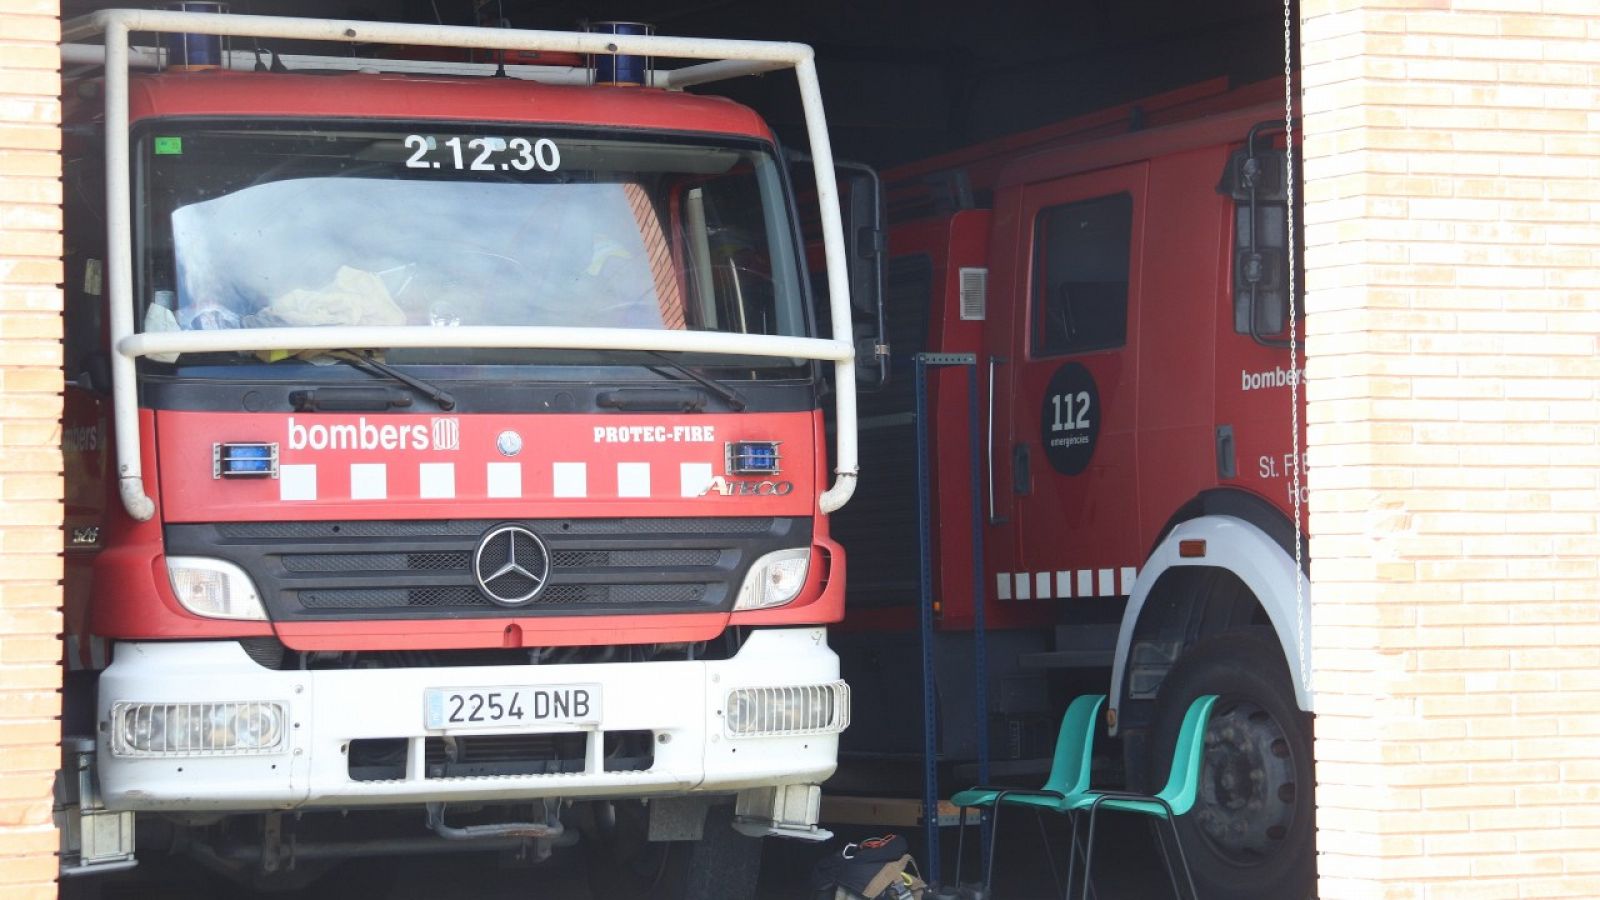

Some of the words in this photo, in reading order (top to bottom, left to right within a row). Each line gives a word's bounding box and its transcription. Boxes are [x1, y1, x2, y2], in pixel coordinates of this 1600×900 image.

[404, 134, 561, 172] 2.12.30
[1051, 390, 1091, 431] 112
[287, 417, 429, 450] bombers
[593, 425, 715, 443] PROTEC-FIRE
[1259, 455, 1280, 479] St.
[448, 691, 525, 723] 2254
[533, 689, 590, 720] DNB
